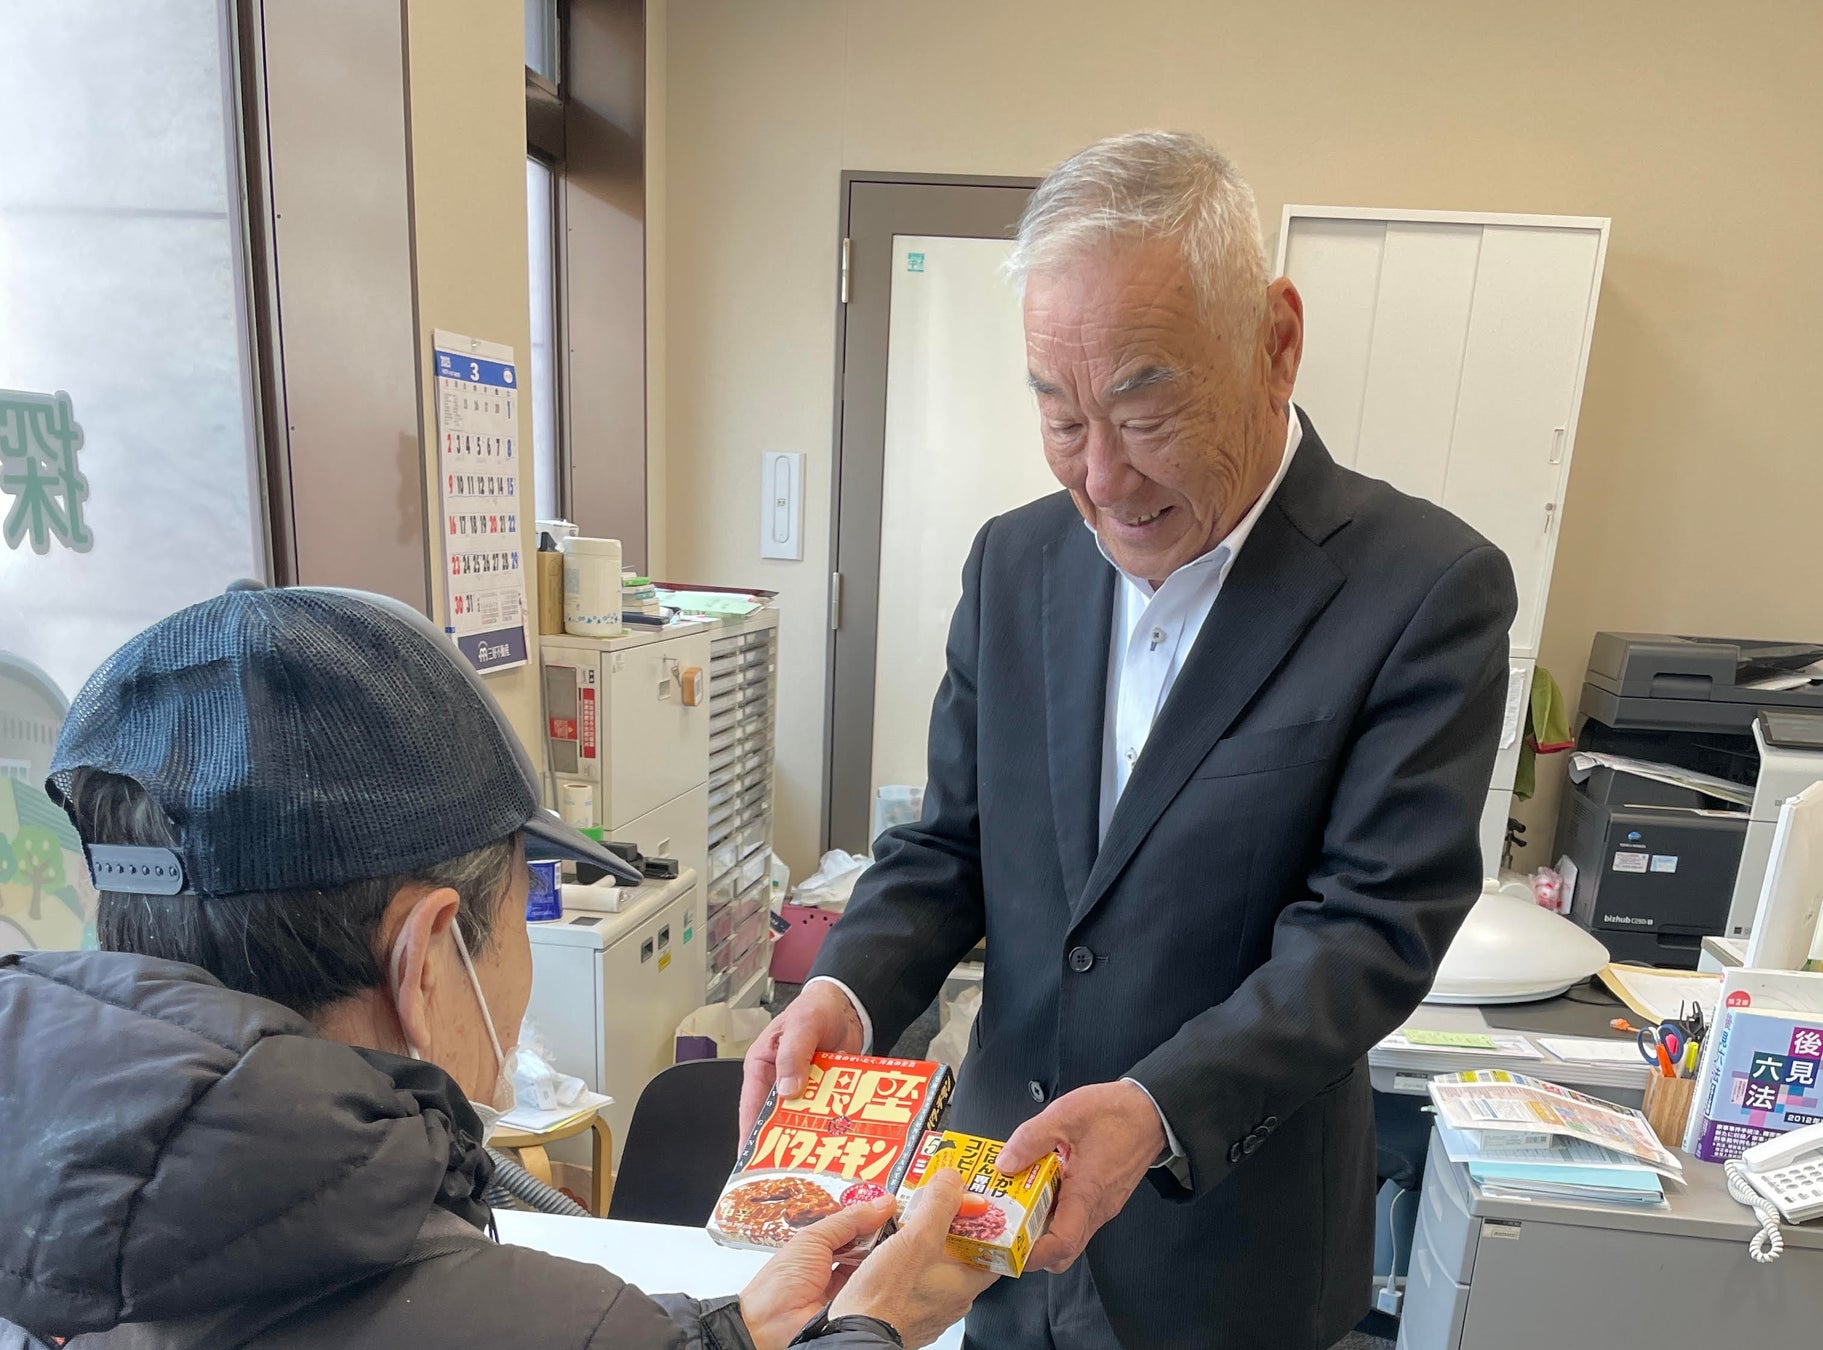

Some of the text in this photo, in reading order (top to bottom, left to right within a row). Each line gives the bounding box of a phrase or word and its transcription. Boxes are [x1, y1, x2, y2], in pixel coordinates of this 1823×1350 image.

[470, 362, 480, 382] 3
[447, 433, 512, 458] 2 3 4 5 6 7 8
[448, 474, 514, 496] 9 10 11 12 13 14 15
[449, 514, 516, 535] 16 17 18 19 20 21 22
[452, 551, 518, 575] 23 24 25 26 27 28 29
[455, 595, 463, 615] 30
[466, 594, 473, 614] 31
[1603, 914, 1631, 924] bizhub
[1785, 1030, 1822, 1084] 後見
[782, 1064, 928, 1124] 銀座
[1746, 1056, 1783, 1110] 六法
[1787, 1114, 1823, 1125] 2012年
[738, 1120, 764, 1166] GINZA
[751, 1127, 899, 1181] バターチキン
[924, 1138, 941, 1154] 5
[957, 1139, 983, 1174] コンビ
[720, 1205, 749, 1221] 中辛
